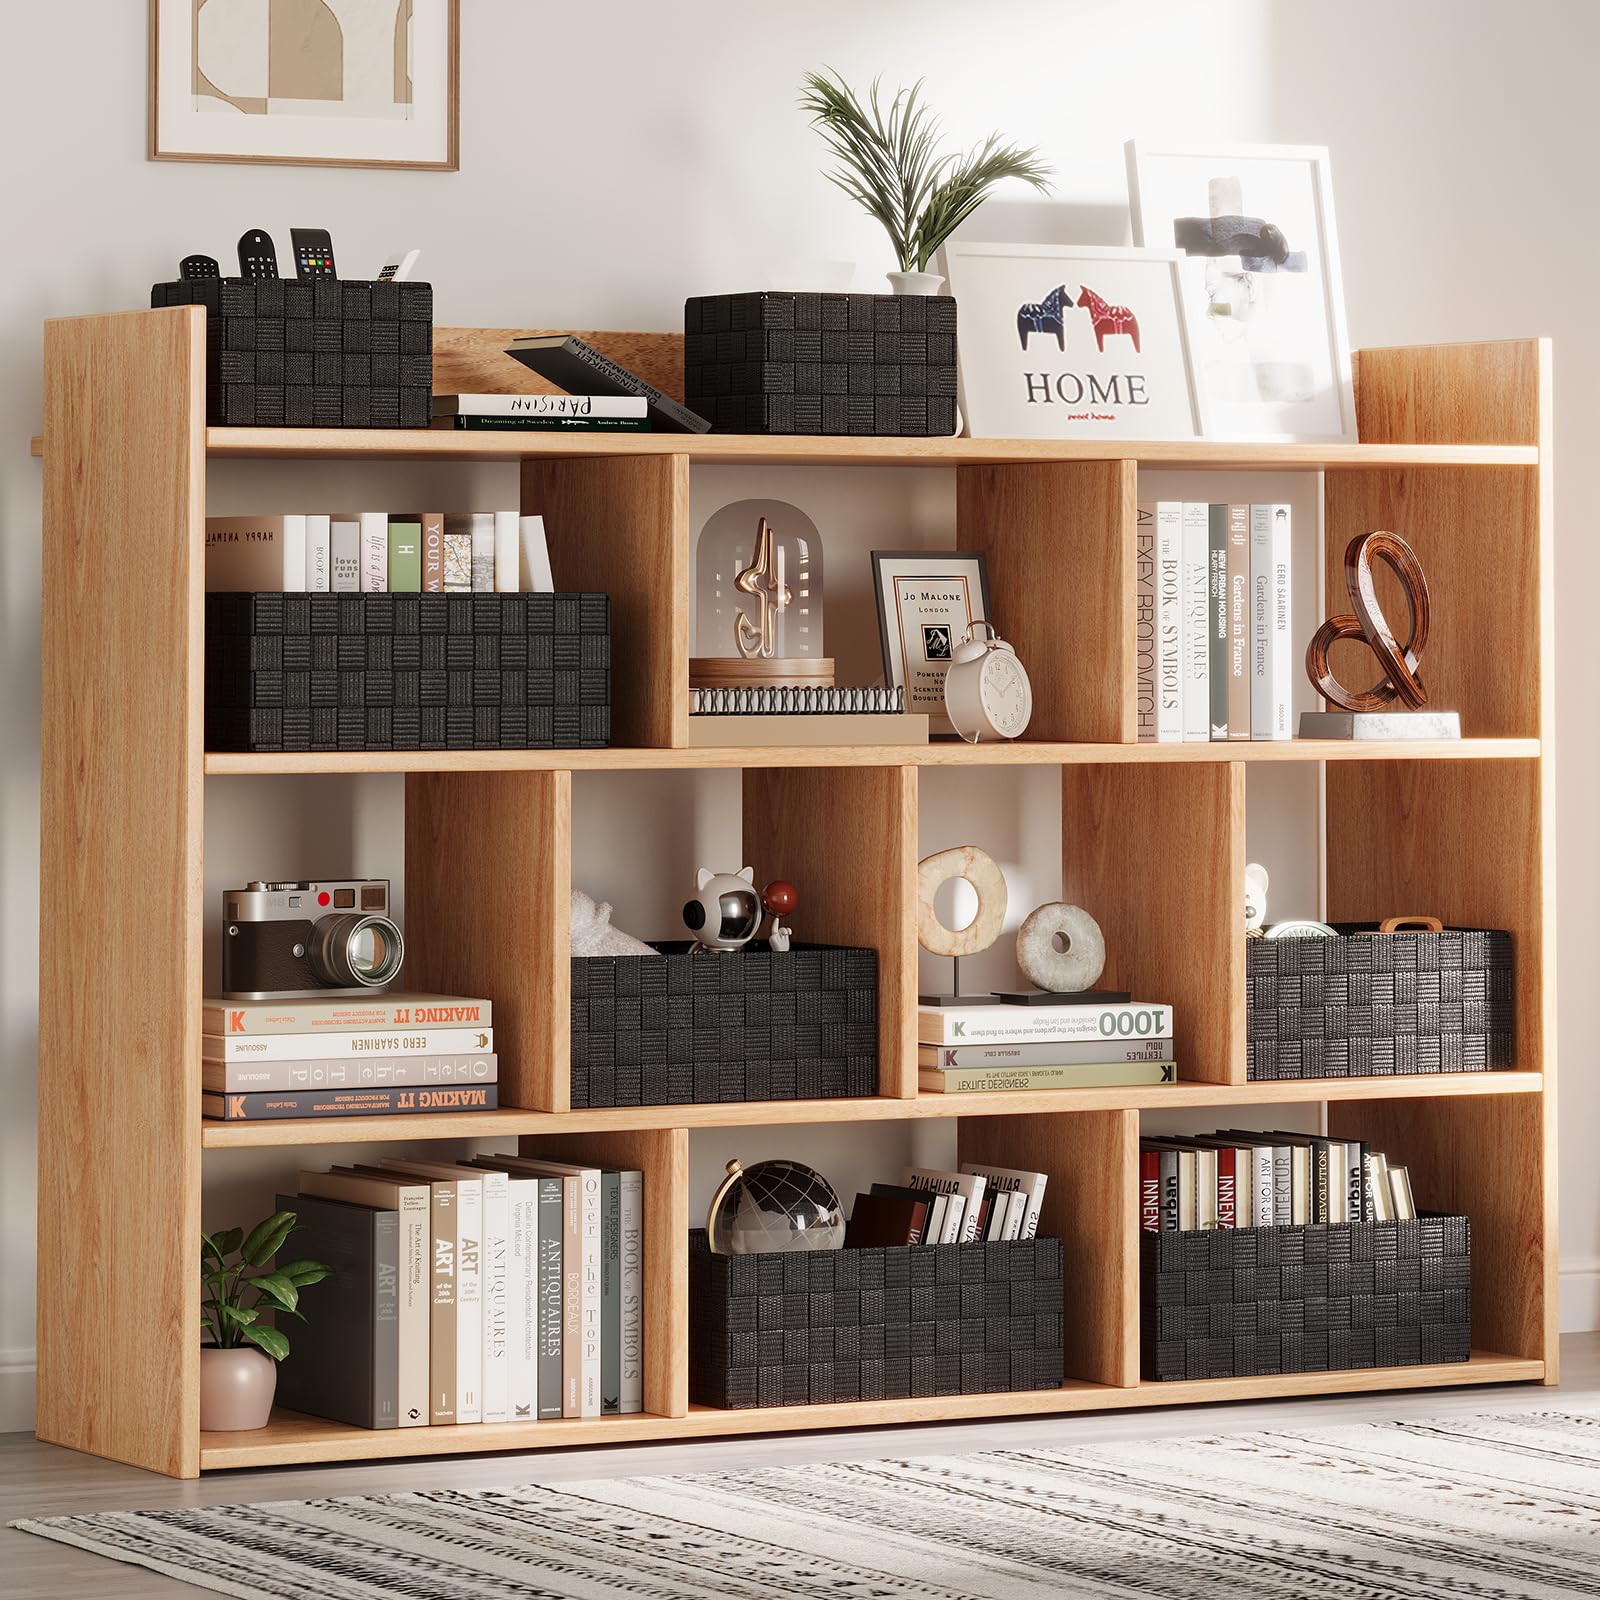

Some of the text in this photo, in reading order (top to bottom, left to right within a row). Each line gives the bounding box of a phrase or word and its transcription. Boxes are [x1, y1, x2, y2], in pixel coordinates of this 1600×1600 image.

[571, 338, 662, 399] DER PRIMZAHLEN
[575, 350, 639, 393] EINSAMKEIT
[1024, 373, 1149, 405] HOME
[366, 535, 385, 550] life
[427, 523, 440, 573] YOUR
[1162, 538, 1170, 554] THE
[1162, 559, 1178, 606] BOOK
[1218, 550, 1227, 639] NEW URBAN HOUSING
[1277, 564, 1286, 631] EERO SAARINEN
[1190, 563, 1207, 680] ANTIQUAIRES
[1233, 575, 1245, 677] Gardens in France
[1256, 575, 1268, 677] Gardens in France
[1162, 625, 1178, 709] SYMBOLS
[230, 1010, 246, 1033] K
[393, 1007, 480, 1024] MAKING IT
[952, 1021, 966, 1037] K
[1005, 1028, 1022, 1036] where
[1035, 1025, 1056, 1035] gardens
[1067, 1026, 1075, 1034] for
[1076, 1025, 1097, 1034] designs
[1099, 1010, 1165, 1036] 1000
[235, 1044, 267, 1052] ASSOULINE
[351, 1037, 427, 1051] EERO SAARINEN
[986, 1029, 997, 1037] find
[944, 1049, 958, 1066] K
[1126, 1051, 1163, 1060] TEXTILES
[237, 1073, 271, 1081] ASSOULINE
[229, 1096, 246, 1118] K
[398, 1090, 486, 1108] MAKING IT
[1261, 1157, 1271, 1176] ART
[1364, 1153, 1372, 1174] ART
[1160, 1175, 1177, 1230] urban
[1261, 1182, 1272, 1203] FOR
[1318, 1150, 1327, 1223] REVOLUTION
[1348, 1167, 1360, 1221] urban
[1364, 1177, 1374, 1199] FOR
[525, 1201, 533, 1221] Detail
[610, 1186, 618, 1260] TEXTILE DESIGNERS
[513, 1203, 522, 1257] Virginia McLeod
[413, 1257, 422, 1284] Knitting
[435, 1238, 454, 1277] ART
[461, 1238, 479, 1275] ART
[523, 1231, 533, 1278] Contemporary
[378, 1263, 397, 1297] ART
[624, 1208, 639, 1379] THE BOOK OF SYMBOLS
[491, 1237, 506, 1358] ANTIQUAIRES
[525, 1280, 533, 1318] Residential
[545, 1240, 560, 1356] ANTIQUAIRES
[567, 1273, 580, 1335] BORDEAUX
[525, 1319, 533, 1360] Architecture
